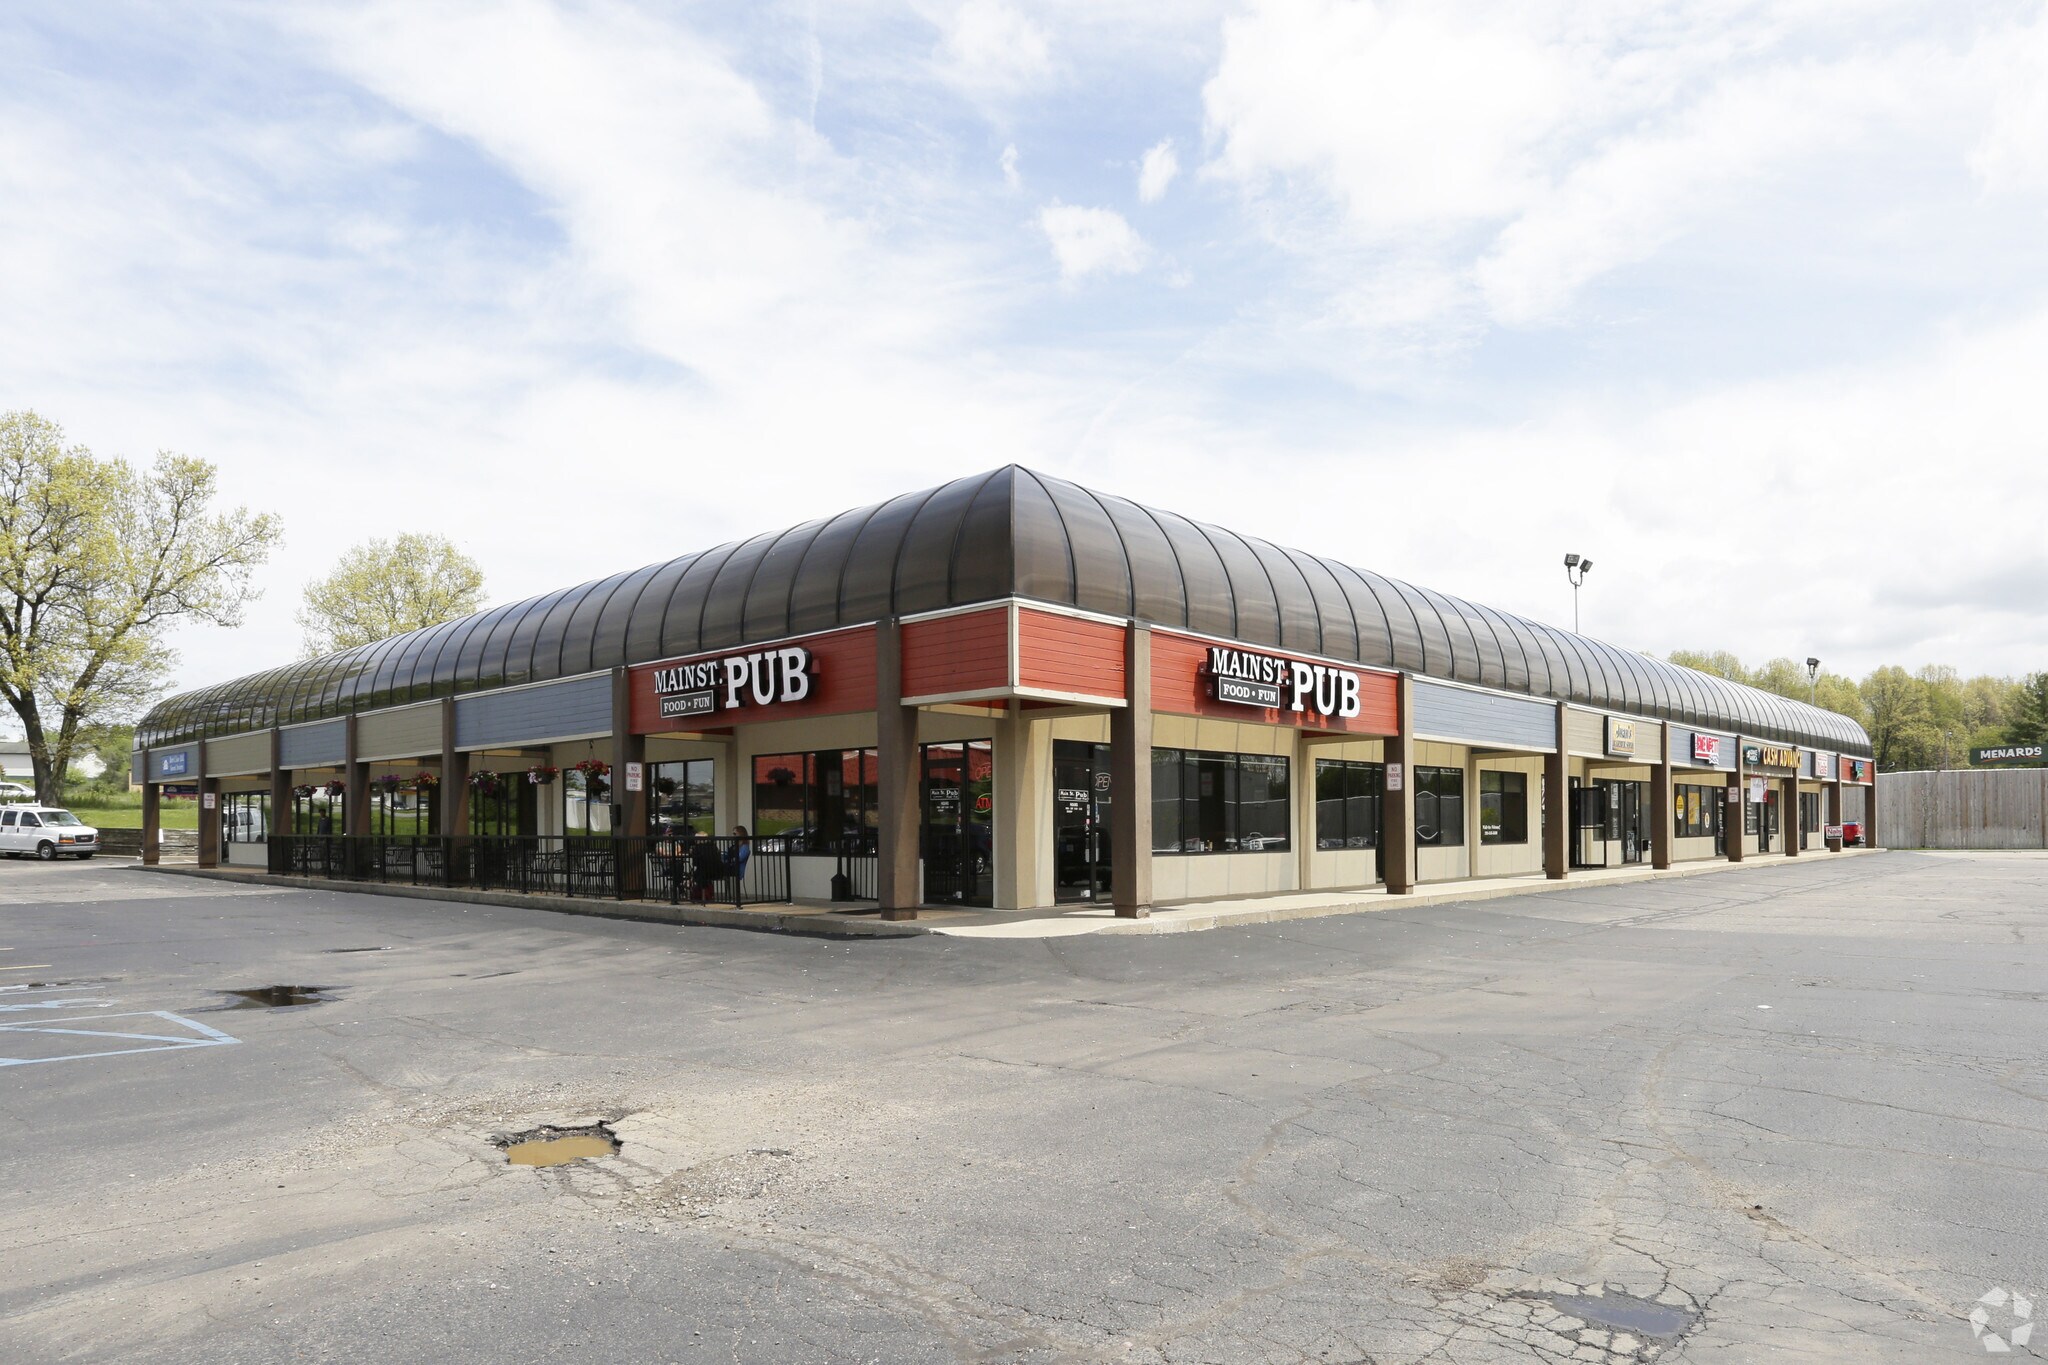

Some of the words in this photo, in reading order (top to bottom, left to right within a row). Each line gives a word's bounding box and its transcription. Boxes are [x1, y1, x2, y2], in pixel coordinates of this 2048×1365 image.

[724, 647, 809, 709] PUB
[1223, 683, 1250, 698] FOOD
[1258, 690, 1276, 702] FUN
[1291, 661, 1361, 718] PUB
[663, 700, 686, 713] FOOD
[693, 697, 710, 709] FUN
[1763, 747, 1778, 766] CASH
[1980, 746, 2042, 759] MENARDS
